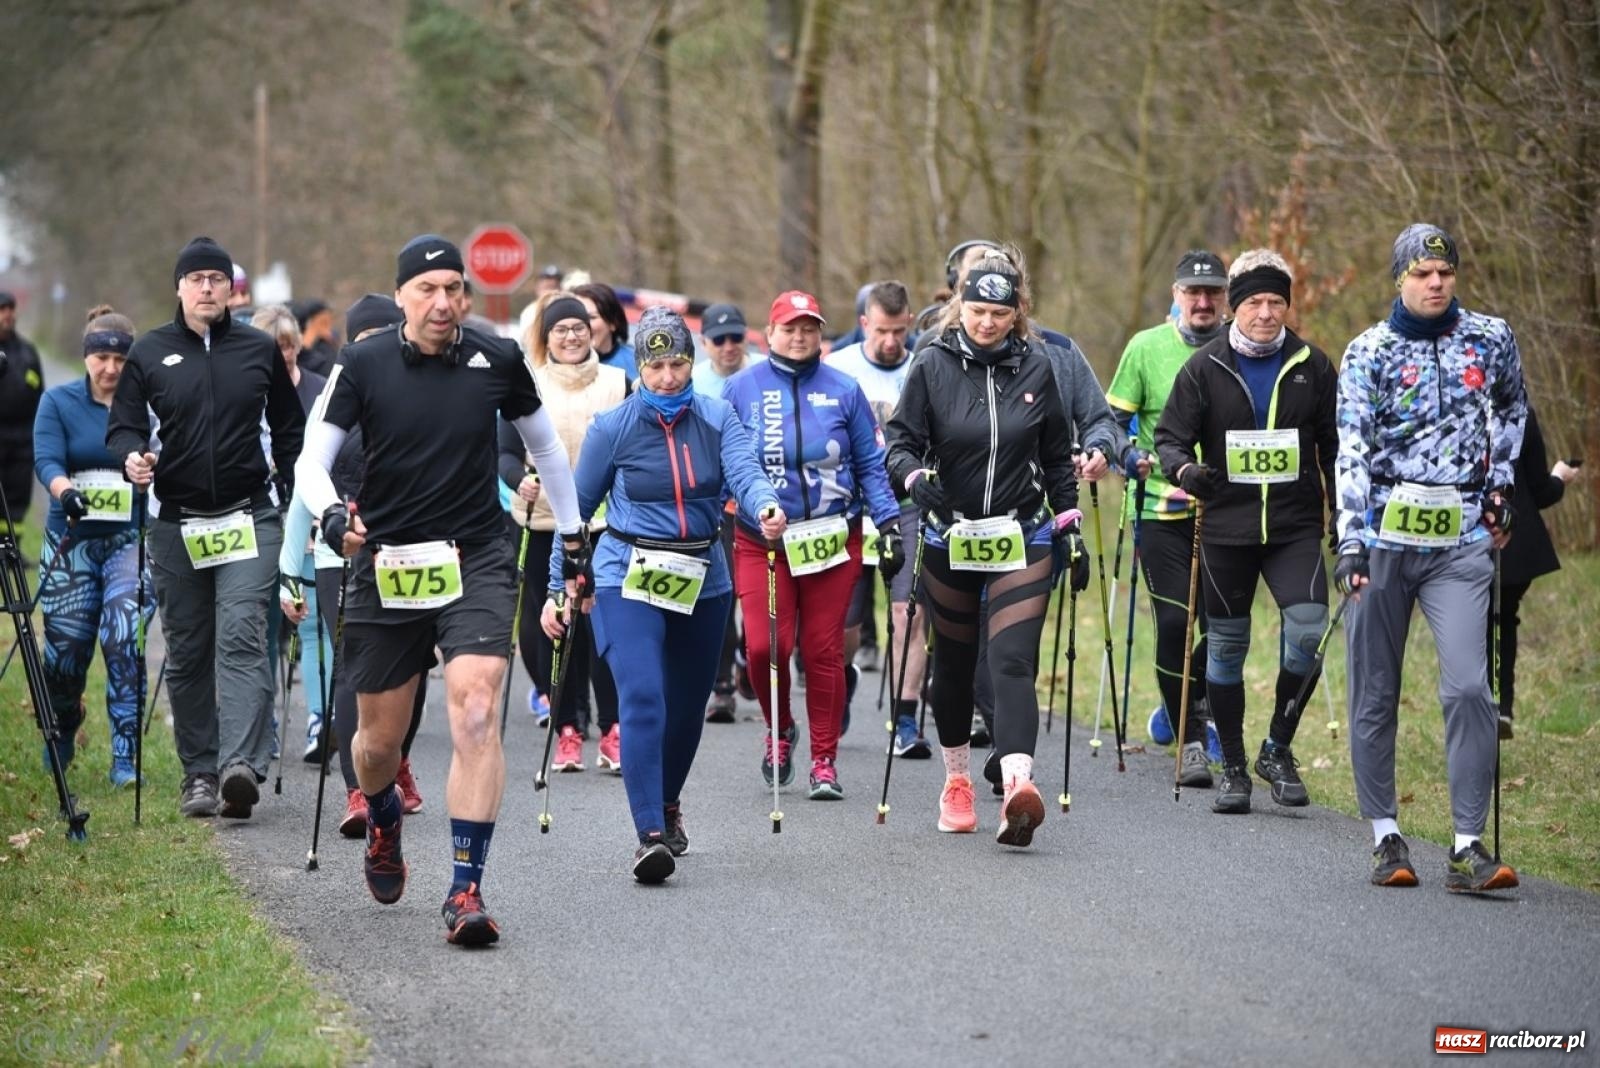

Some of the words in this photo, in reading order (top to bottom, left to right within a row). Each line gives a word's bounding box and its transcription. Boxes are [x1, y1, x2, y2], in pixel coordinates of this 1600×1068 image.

[472, 246, 521, 271] STOP
[763, 389, 788, 489] RUNNERS
[1239, 449, 1288, 473] 183
[83, 489, 121, 511] 64
[1396, 506, 1451, 535] 158
[196, 529, 245, 557] 152
[798, 534, 838, 564] 181
[961, 537, 1013, 561] 159
[388, 566, 446, 597] 175
[636, 570, 692, 599] 167
